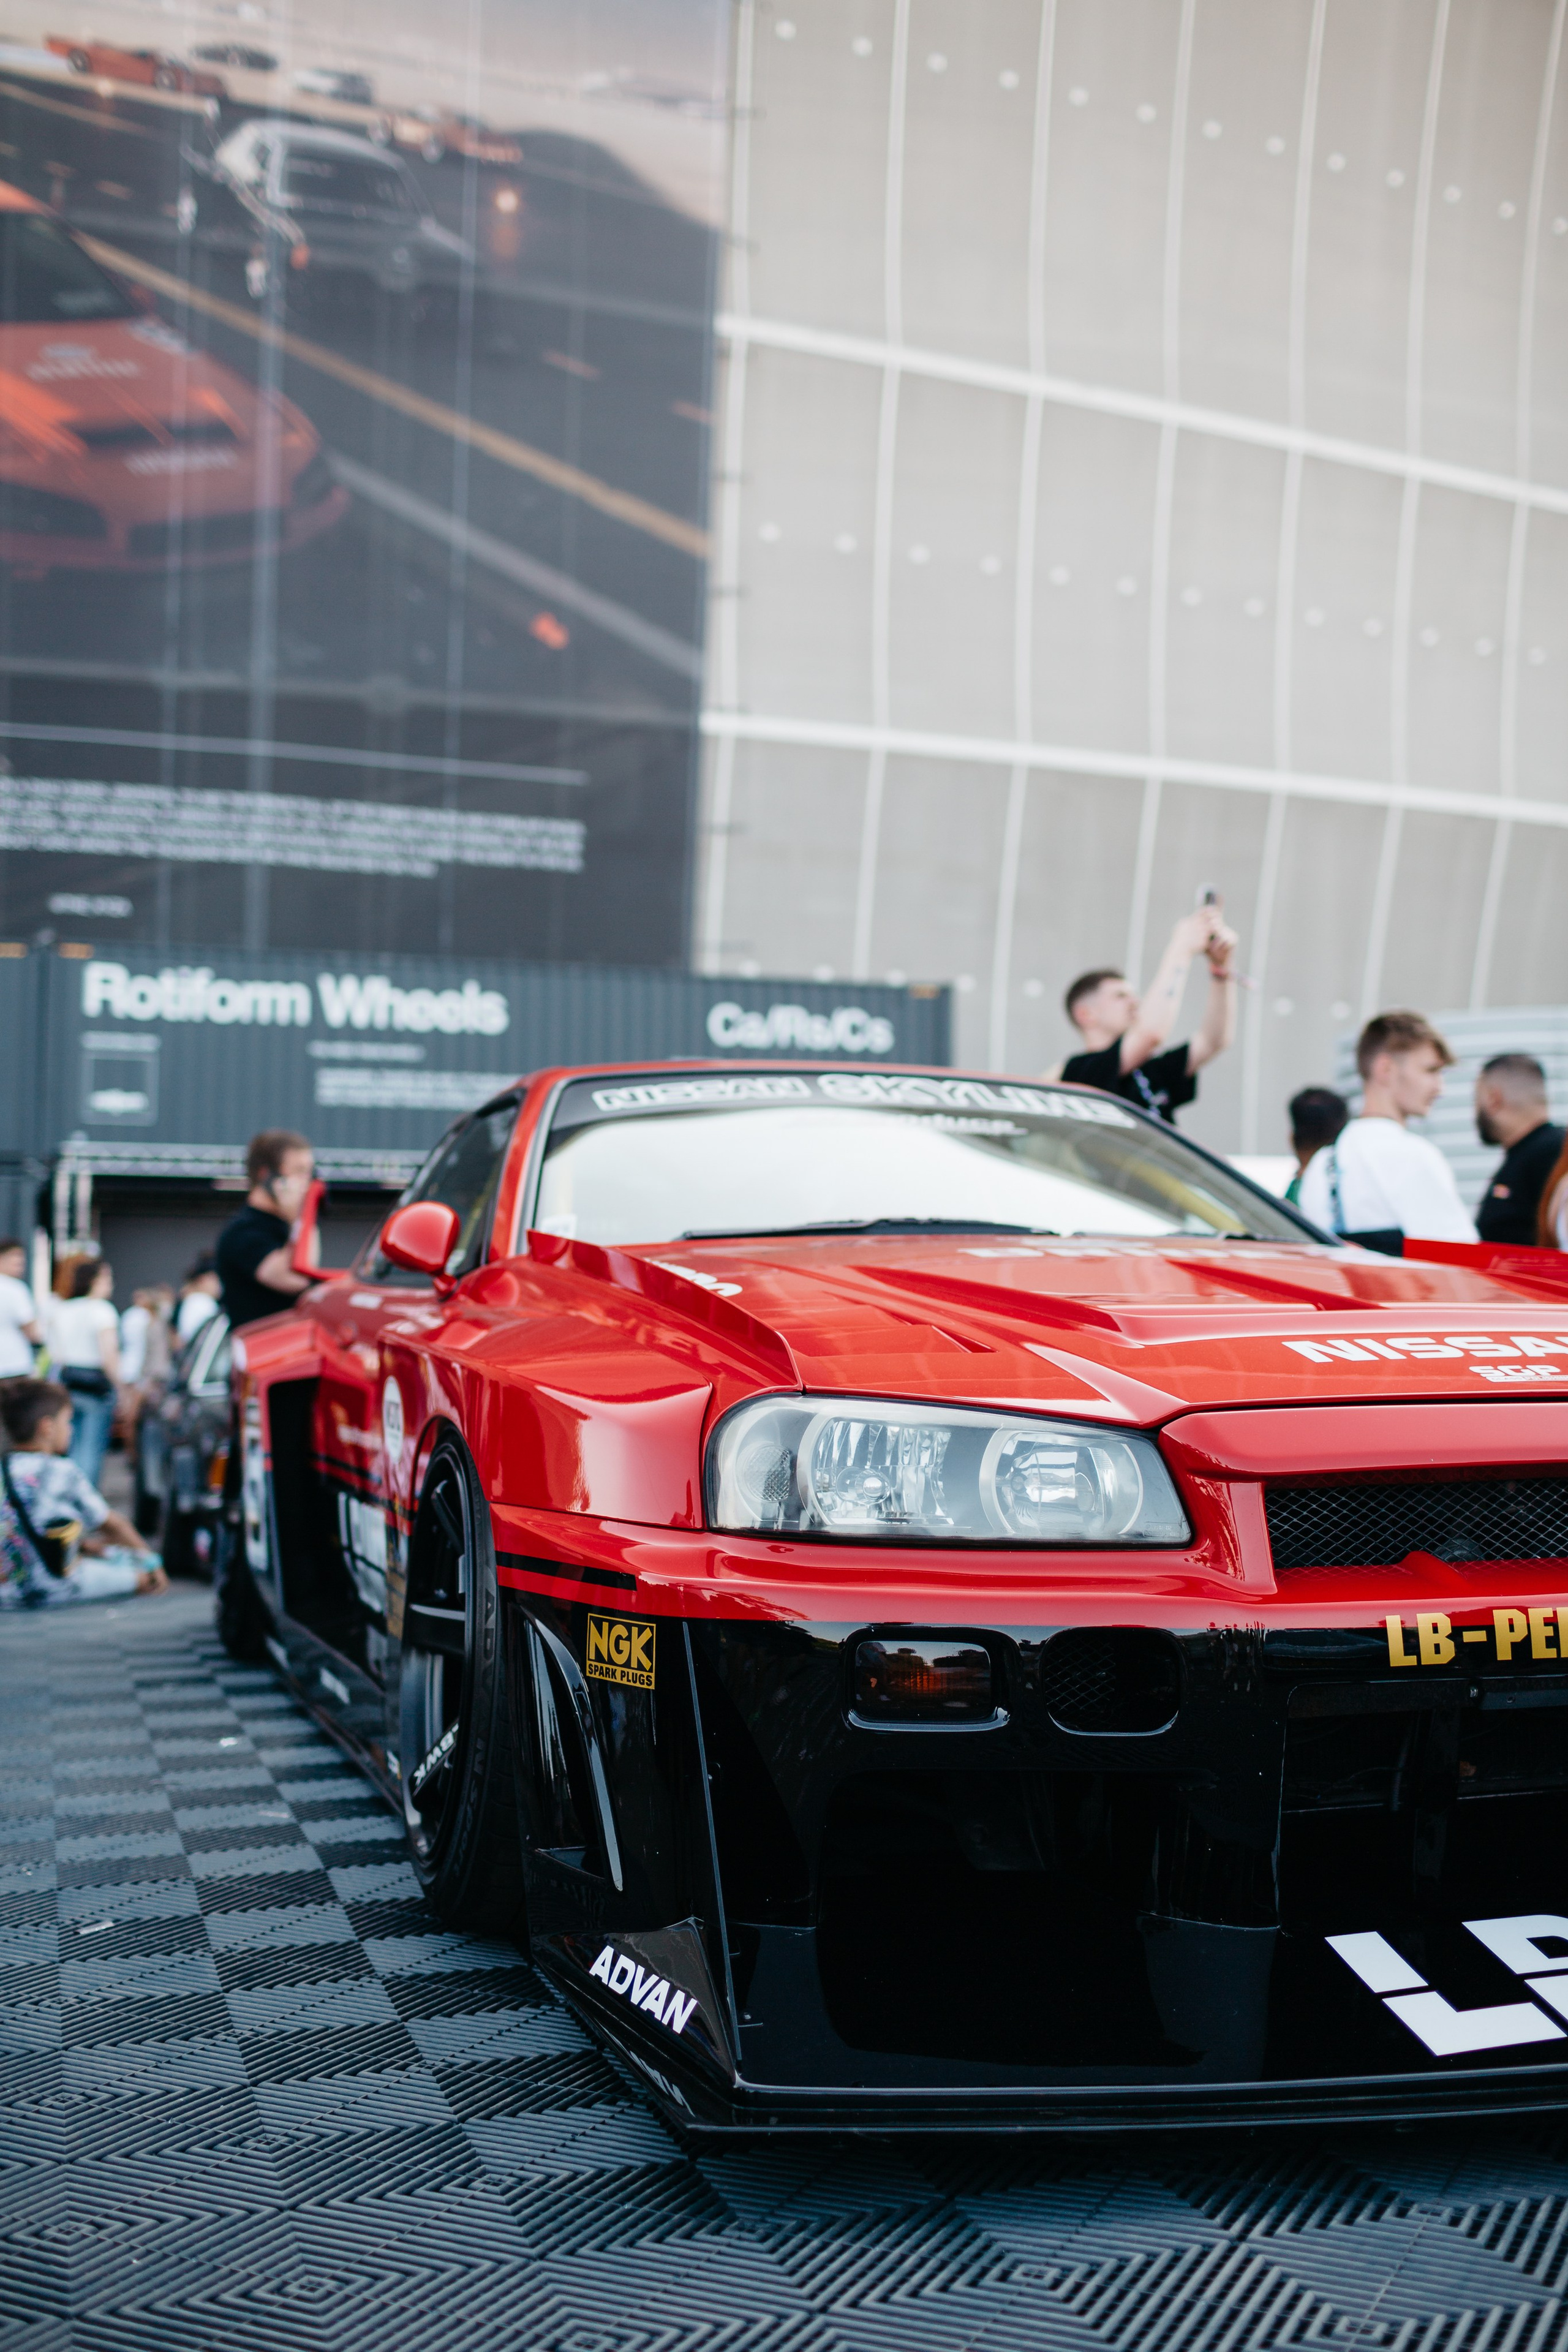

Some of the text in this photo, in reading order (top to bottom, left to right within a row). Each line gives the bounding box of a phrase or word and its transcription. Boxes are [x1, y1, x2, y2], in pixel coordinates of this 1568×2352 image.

[83, 961, 509, 1035] Rotiform Wheels
[592, 1077, 812, 1112] NISSAN
[818, 1074, 1136, 1129] SKYLINE
[1281, 1336, 1568, 1363] NISSA
[1469, 1365, 1561, 1377] SGP
[589, 1619, 652, 1672] NGK
[588, 1663, 653, 1687] SPARK PLUGS
[589, 1945, 698, 2034] ADVAN
